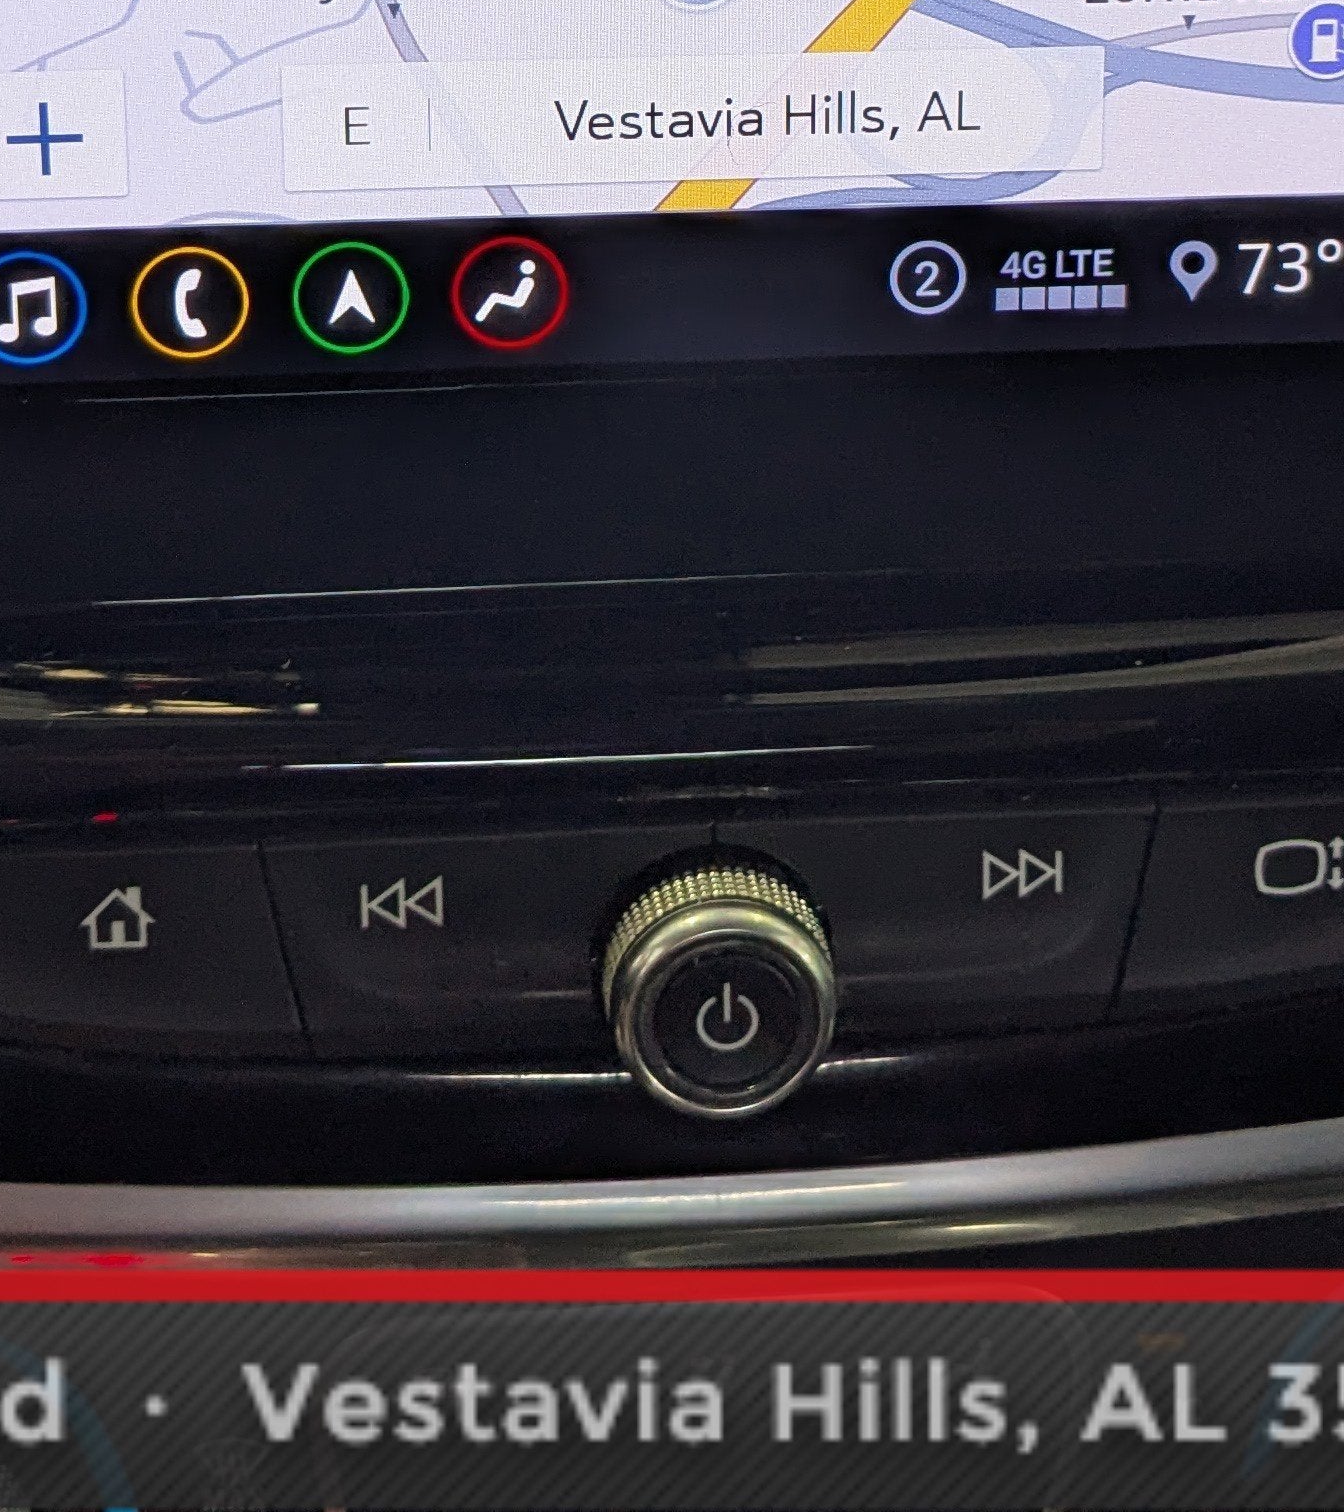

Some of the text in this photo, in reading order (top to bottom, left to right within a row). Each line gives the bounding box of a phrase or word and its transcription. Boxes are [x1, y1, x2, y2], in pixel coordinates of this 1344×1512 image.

[346, 108, 370, 145] E
[553, 91, 981, 142] Vestavia Hills, AL
[914, 261, 942, 299] 2
[1000, 248, 1114, 279] 4G LTE
[1238, 238, 1343, 295] 73°
